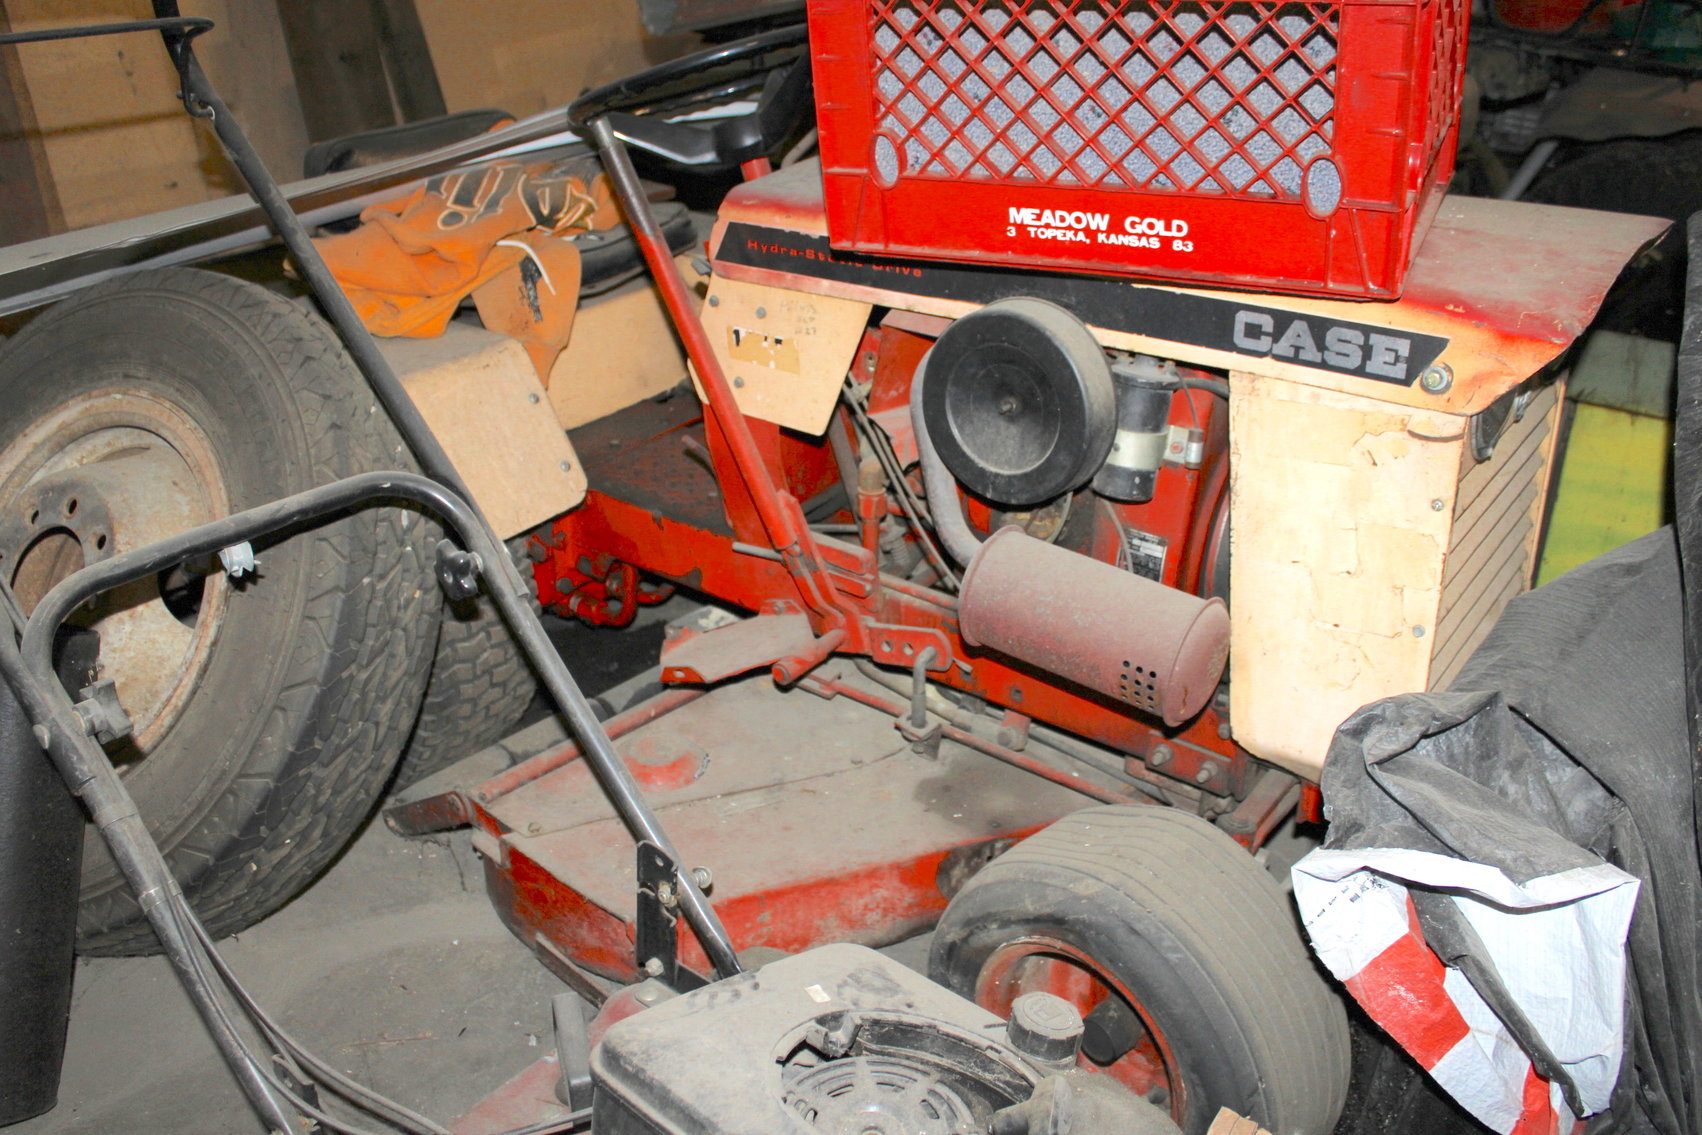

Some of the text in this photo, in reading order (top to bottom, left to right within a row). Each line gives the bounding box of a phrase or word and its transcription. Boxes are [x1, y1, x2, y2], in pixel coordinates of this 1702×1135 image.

[1008, 207, 1189, 237] MEADOW GOLD
[1006, 226, 1194, 252] 3 TOPEKA, KANSAS 83
[1233, 310, 1411, 380] CASE
